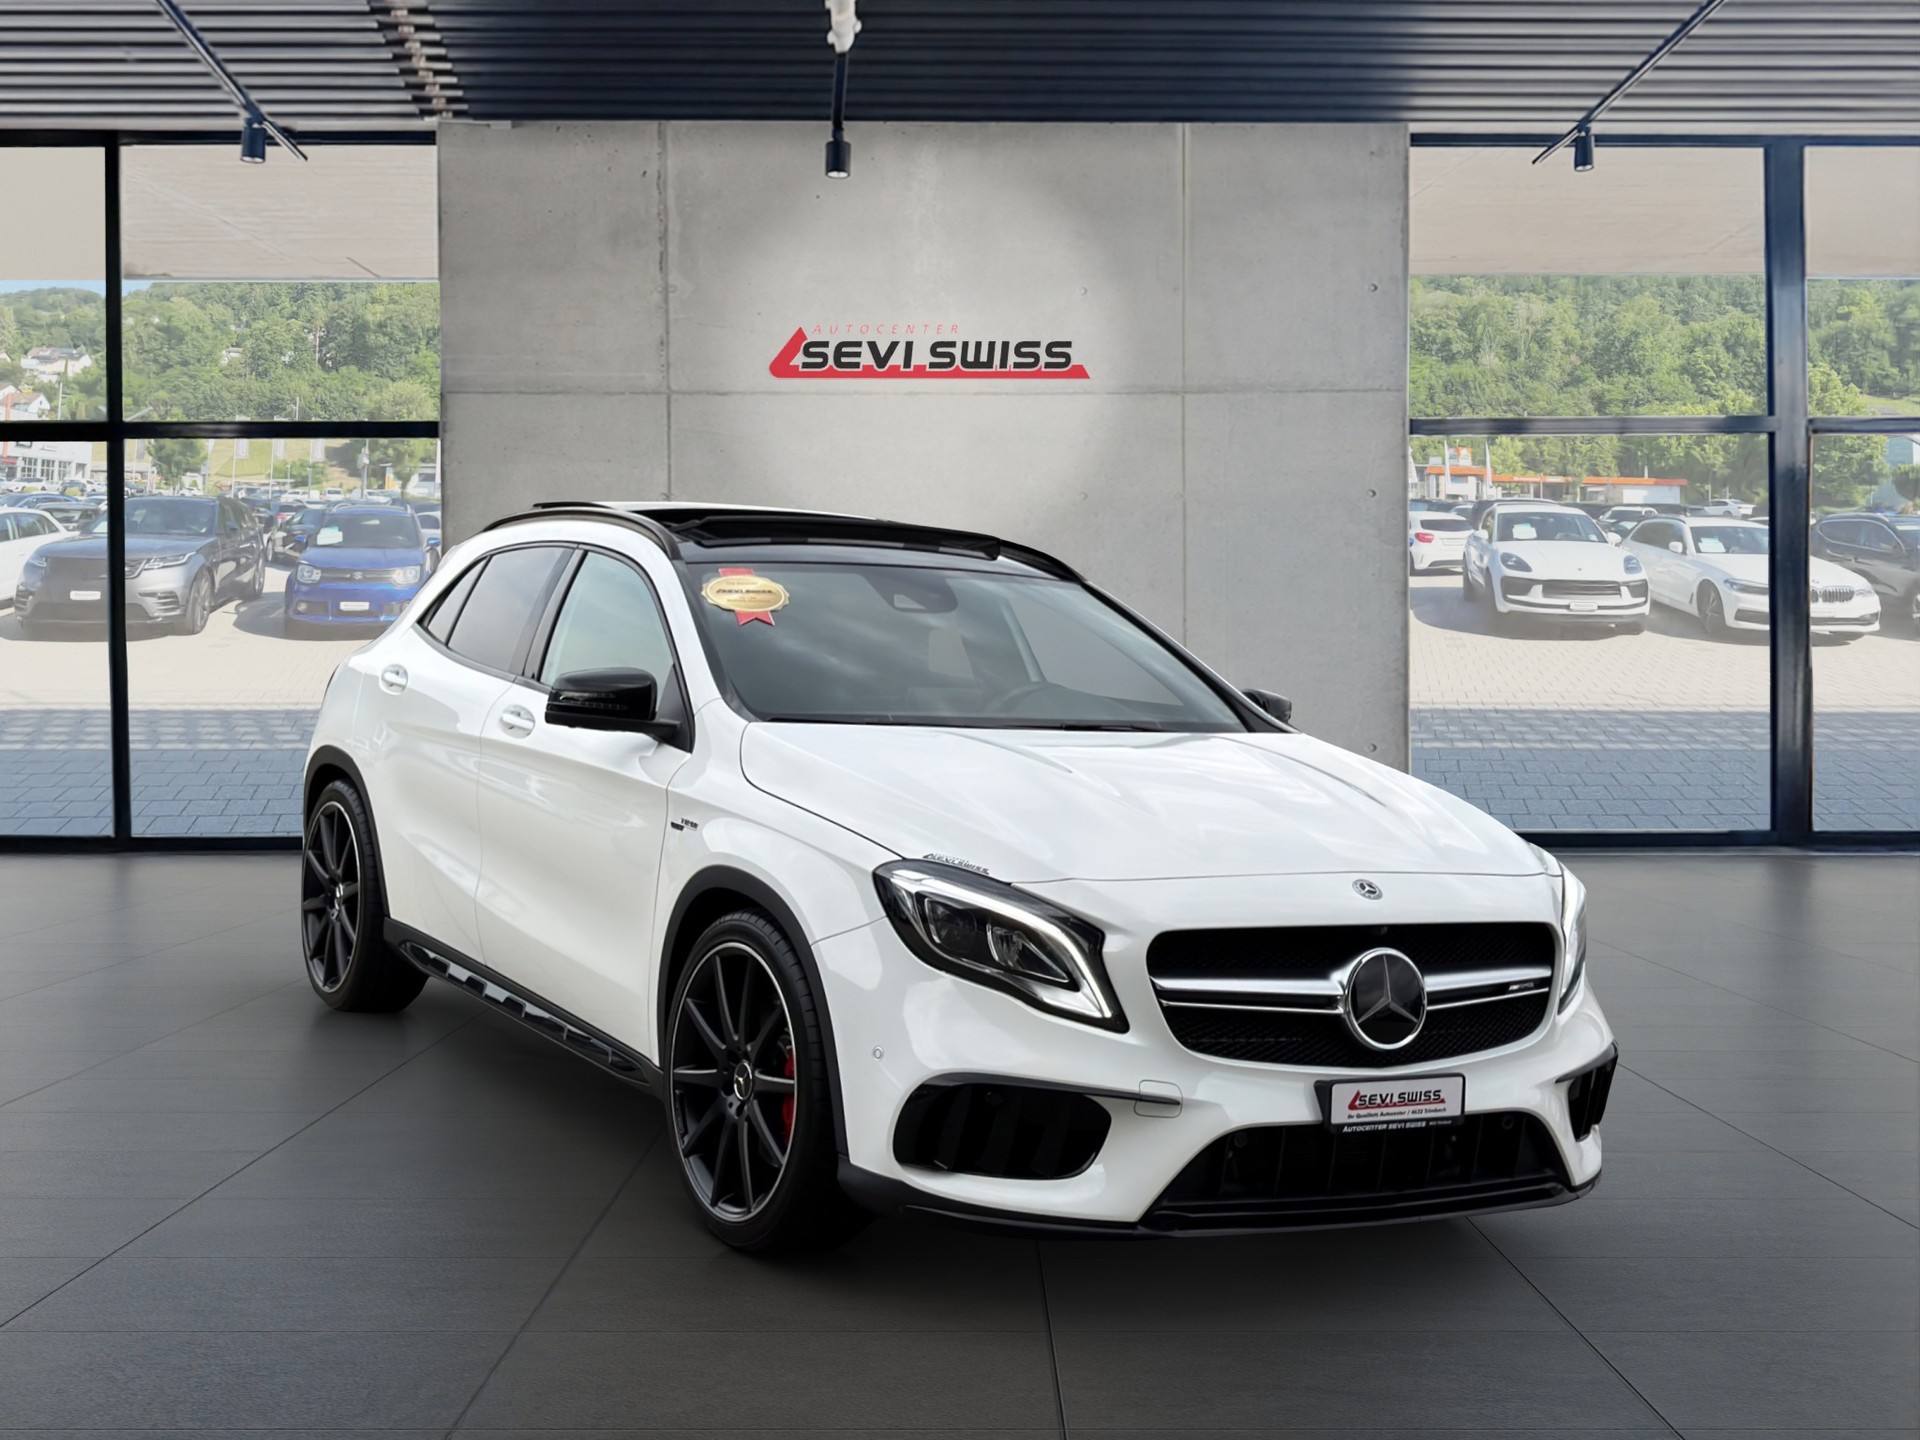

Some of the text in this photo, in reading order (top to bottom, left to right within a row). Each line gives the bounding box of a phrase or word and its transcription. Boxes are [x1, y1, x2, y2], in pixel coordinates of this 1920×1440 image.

[812, 323, 960, 335] AUTOCENTER
[801, 340, 1073, 370] SEVI SWISS
[1358, 1089, 1442, 1106] SEVI SWISS
[1342, 1122, 1388, 1132] AUTOCENTER
[1388, 1122, 1405, 1130] SEVI
